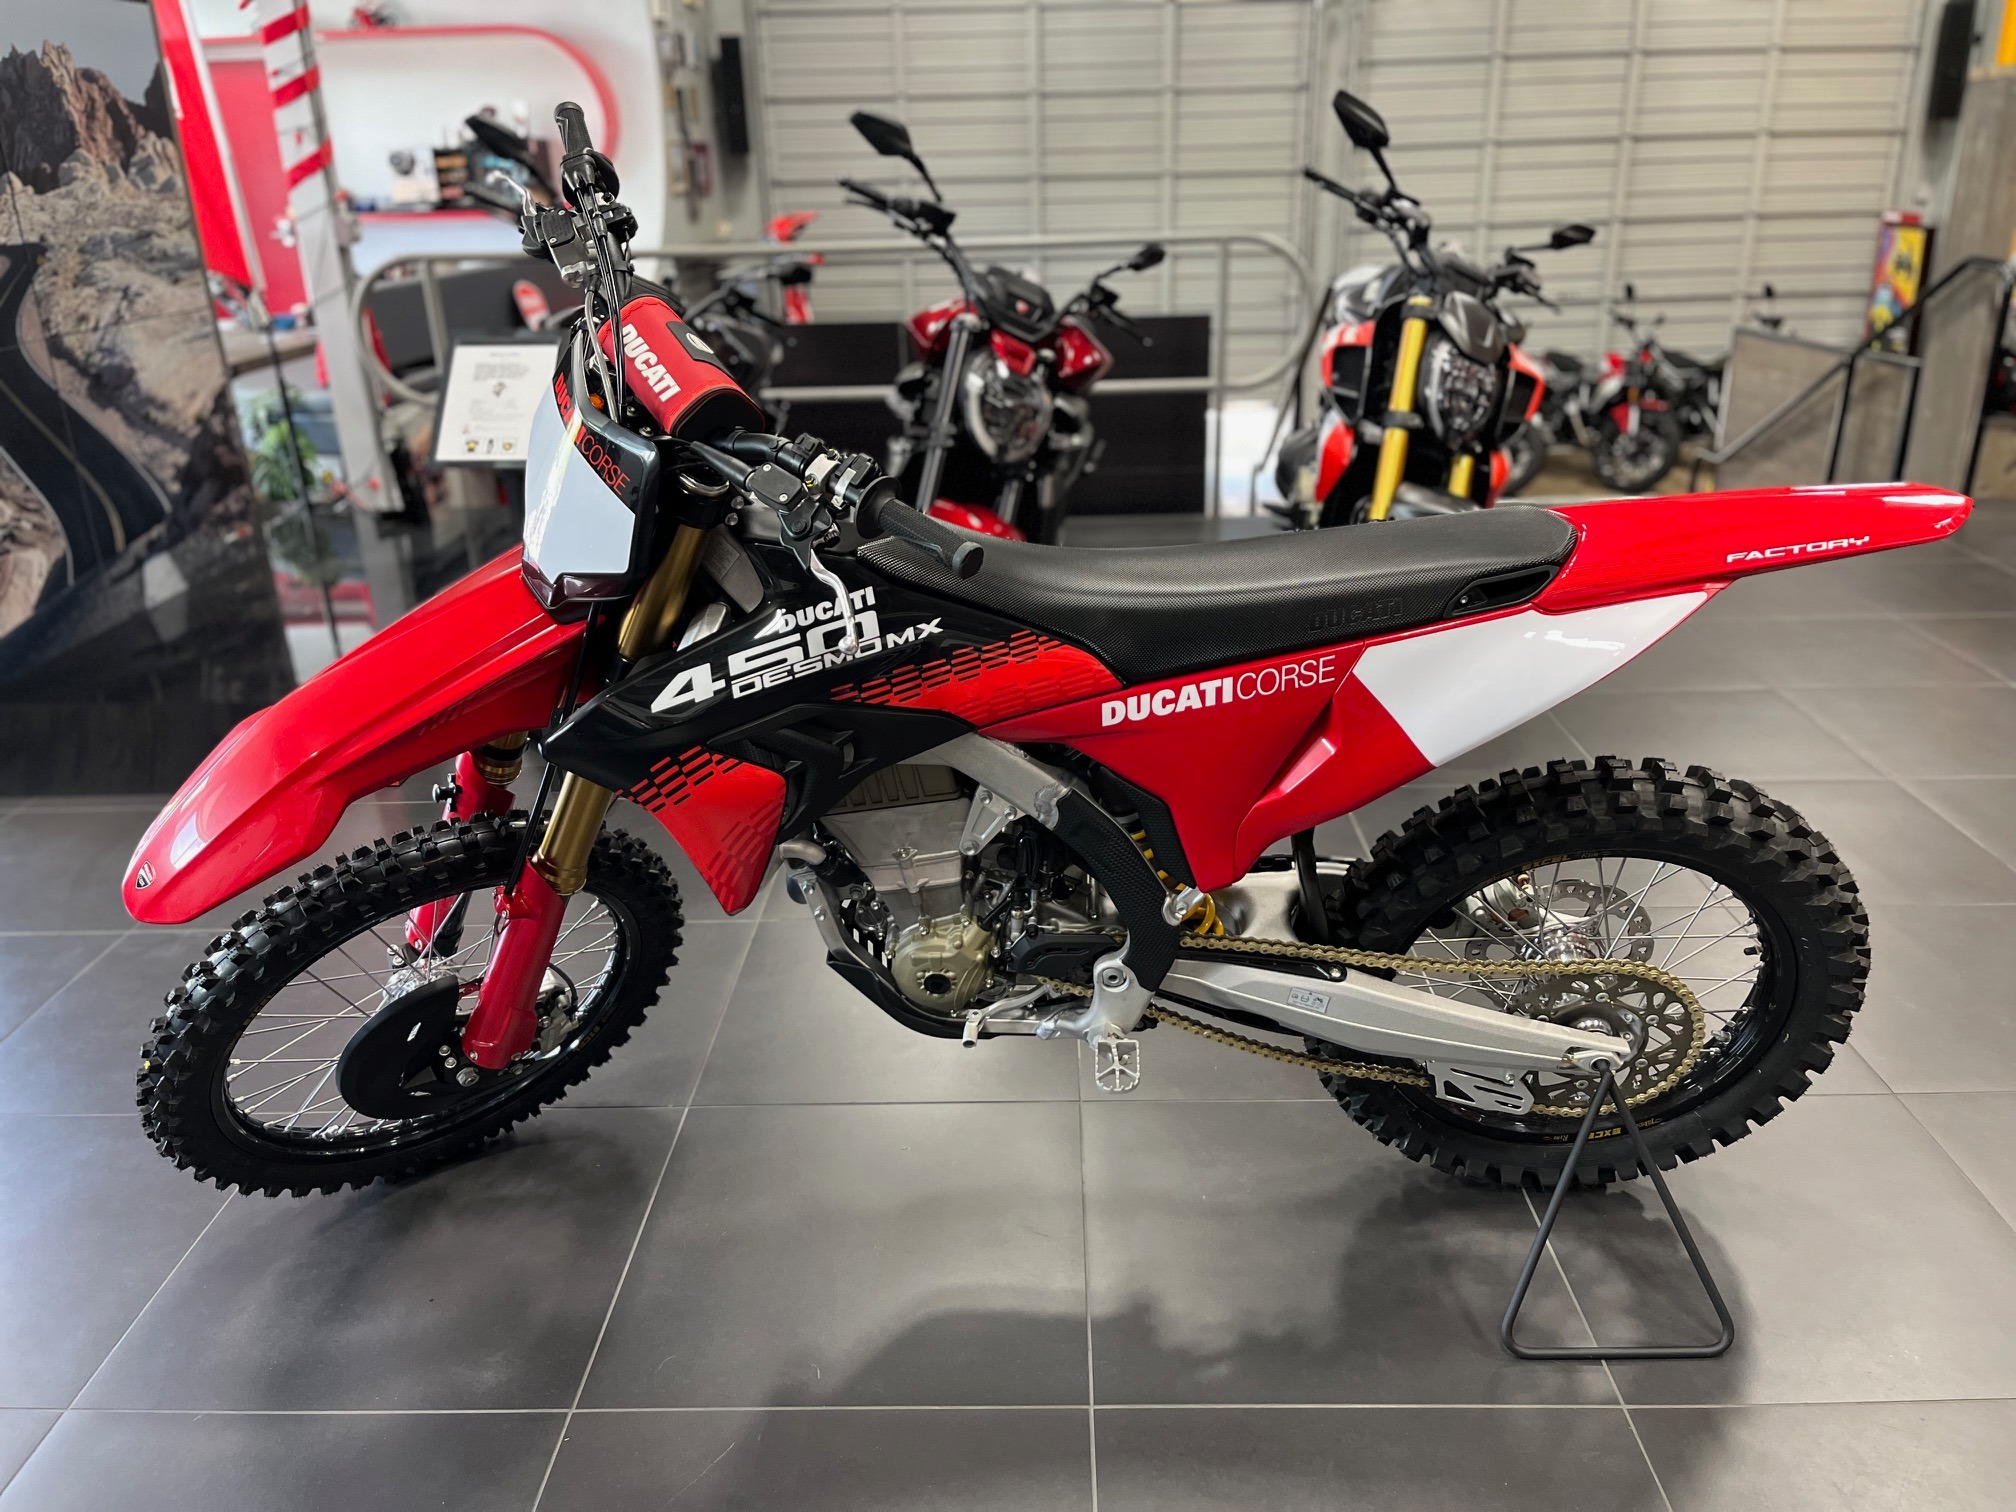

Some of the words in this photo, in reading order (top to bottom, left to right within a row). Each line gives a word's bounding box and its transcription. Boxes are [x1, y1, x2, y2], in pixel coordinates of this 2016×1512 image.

[622, 323, 682, 402] DUCATI
[581, 435, 630, 495] CORSE
[1726, 535, 1870, 563] FACTORY
[651, 610, 880, 713] 450
[731, 637, 883, 699] DESMO
